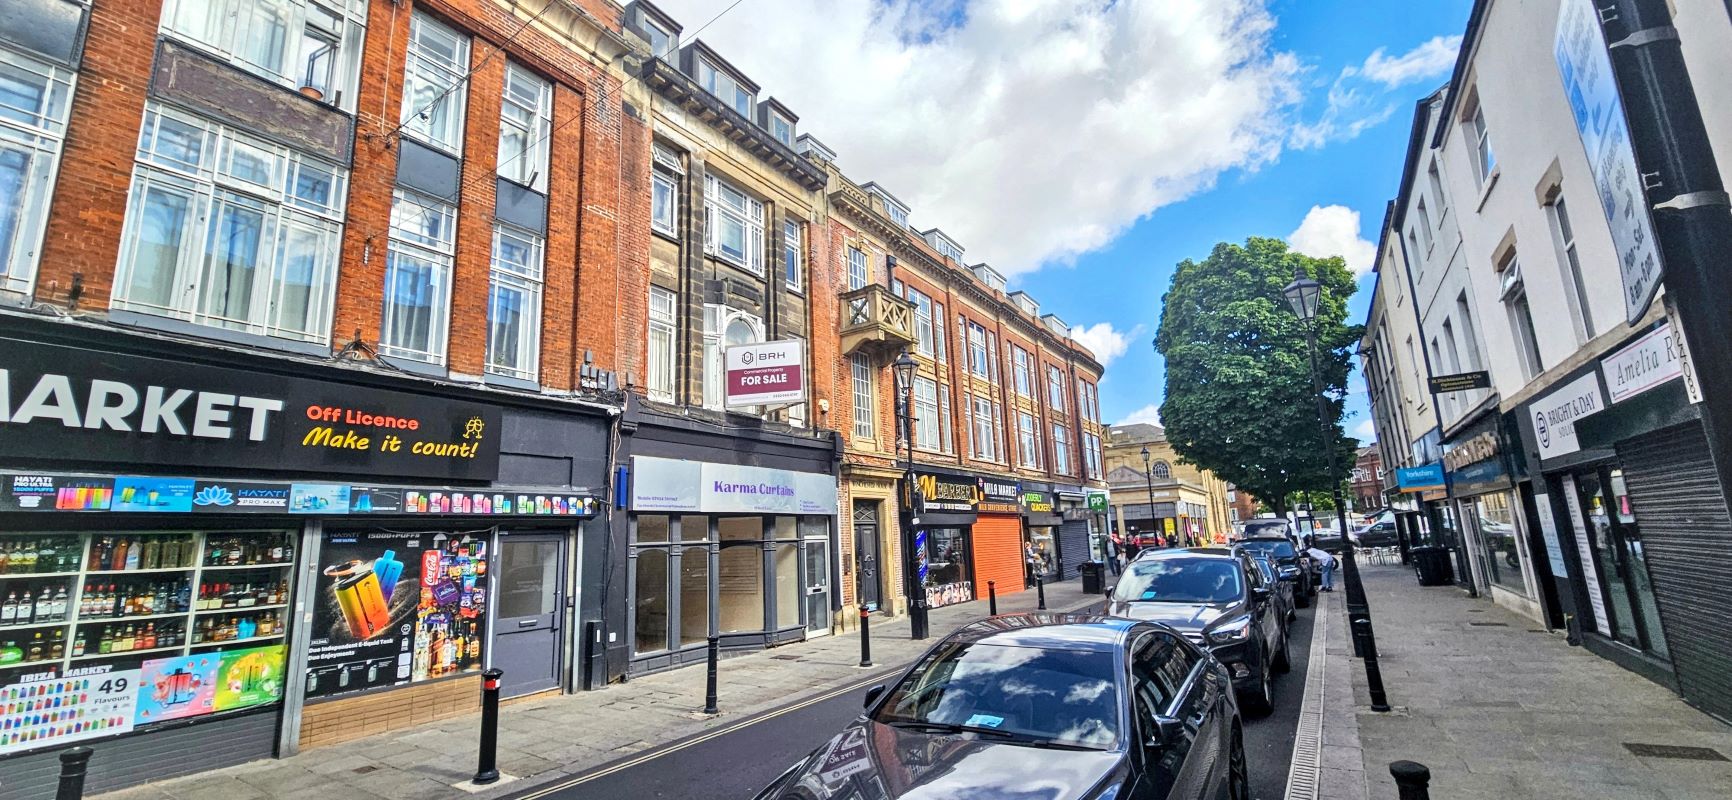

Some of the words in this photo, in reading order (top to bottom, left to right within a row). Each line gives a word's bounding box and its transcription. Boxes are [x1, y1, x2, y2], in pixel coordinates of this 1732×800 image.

[758, 352, 785, 360] BRH
[1617, 348, 1660, 386] Amelia
[741, 375, 761, 386] FOR
[762, 373, 788, 385] SALE
[0, 369, 283, 441] ARKET
[1547, 402, 1573, 427] BRIGHT
[1572, 399, 1580, 417] &
[1577, 391, 1596, 414] DAY
[306, 405, 342, 424] Off
[345, 410, 419, 432] Licence
[302, 427, 371, 452] Make
[381, 432, 401, 453] it
[411, 438, 480, 460] count!
[238, 489, 288, 498] HAYATI
[713, 480, 757, 494] Karma
[758, 483, 796, 497] Curtains
[936, 482, 971, 501] BARBER
[998, 484, 1017, 497] MARKET
[320, 642, 359, 652] Independent
[20, 672, 56, 684] IBIZA
[62, 666, 112, 678] MARKET
[98, 678, 128, 694] 49
[94, 694, 131, 706] Flavours
